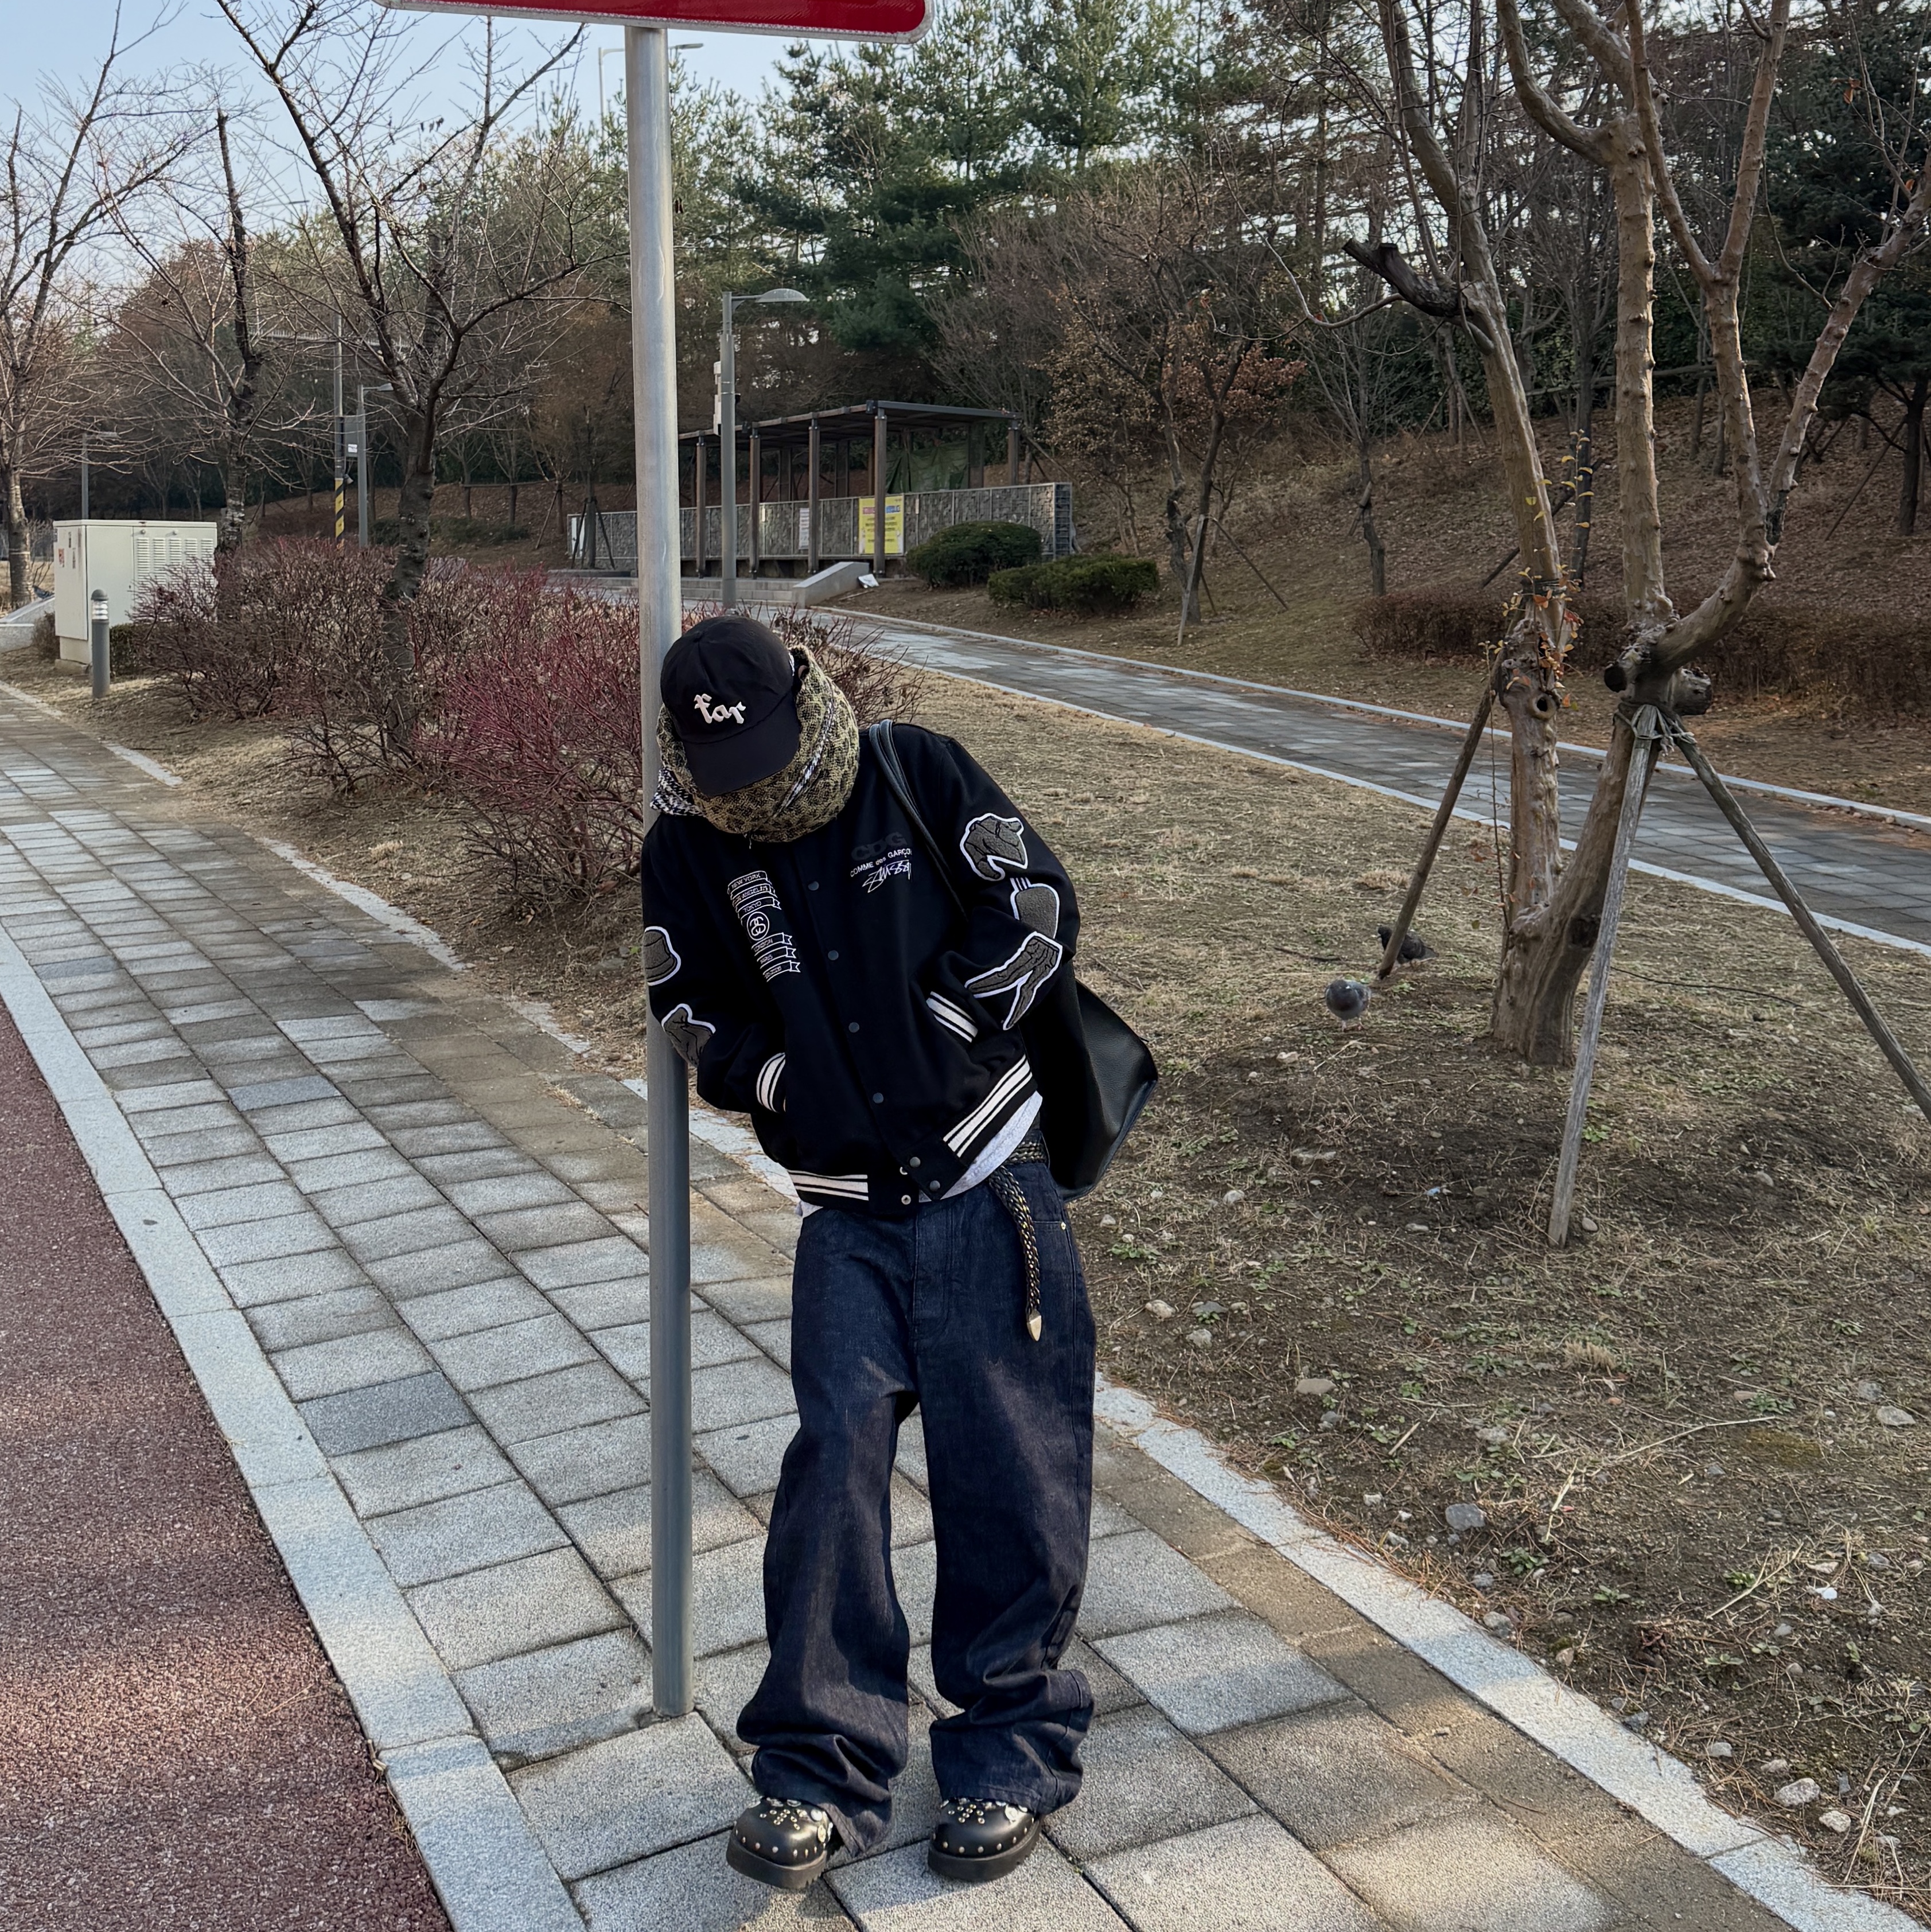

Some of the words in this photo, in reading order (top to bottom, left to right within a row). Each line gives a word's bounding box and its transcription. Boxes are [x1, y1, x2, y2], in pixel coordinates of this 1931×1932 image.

[851, 832, 908, 860] CDG
[743, 872, 761, 882] YORK
[850, 862, 874, 878] COMME
[742, 901, 762, 913] TOKYO
